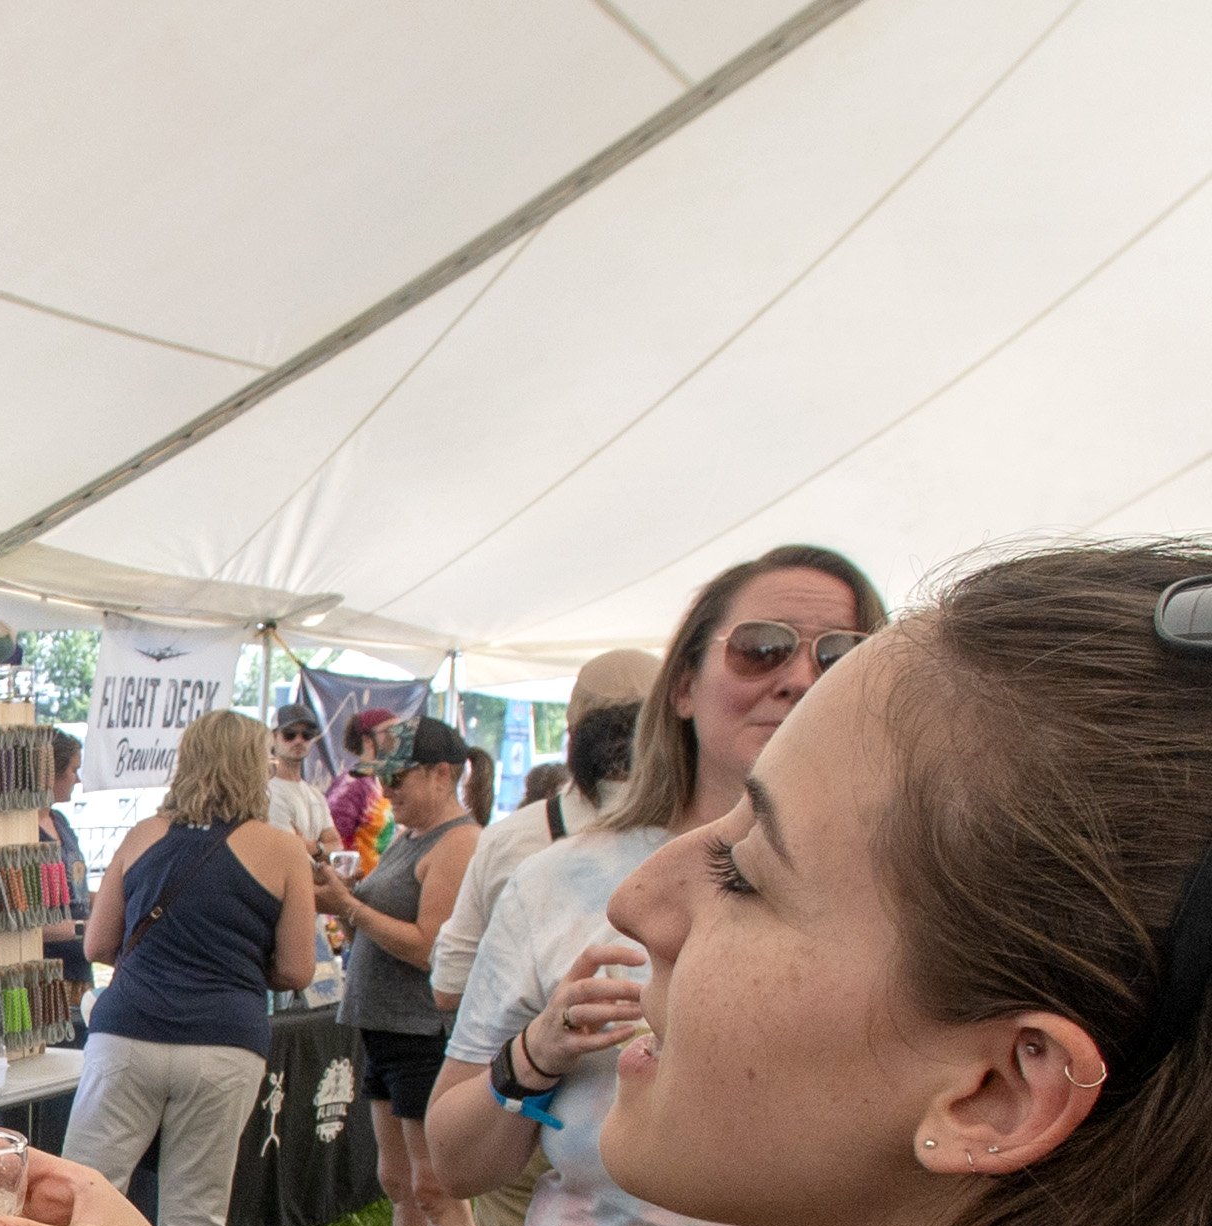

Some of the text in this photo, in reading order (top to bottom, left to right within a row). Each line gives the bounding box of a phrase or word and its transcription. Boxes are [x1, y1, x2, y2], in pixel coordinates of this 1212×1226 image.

[98, 676, 220, 728] FLIGHT DECK
[115, 737, 177, 781] Brewing
